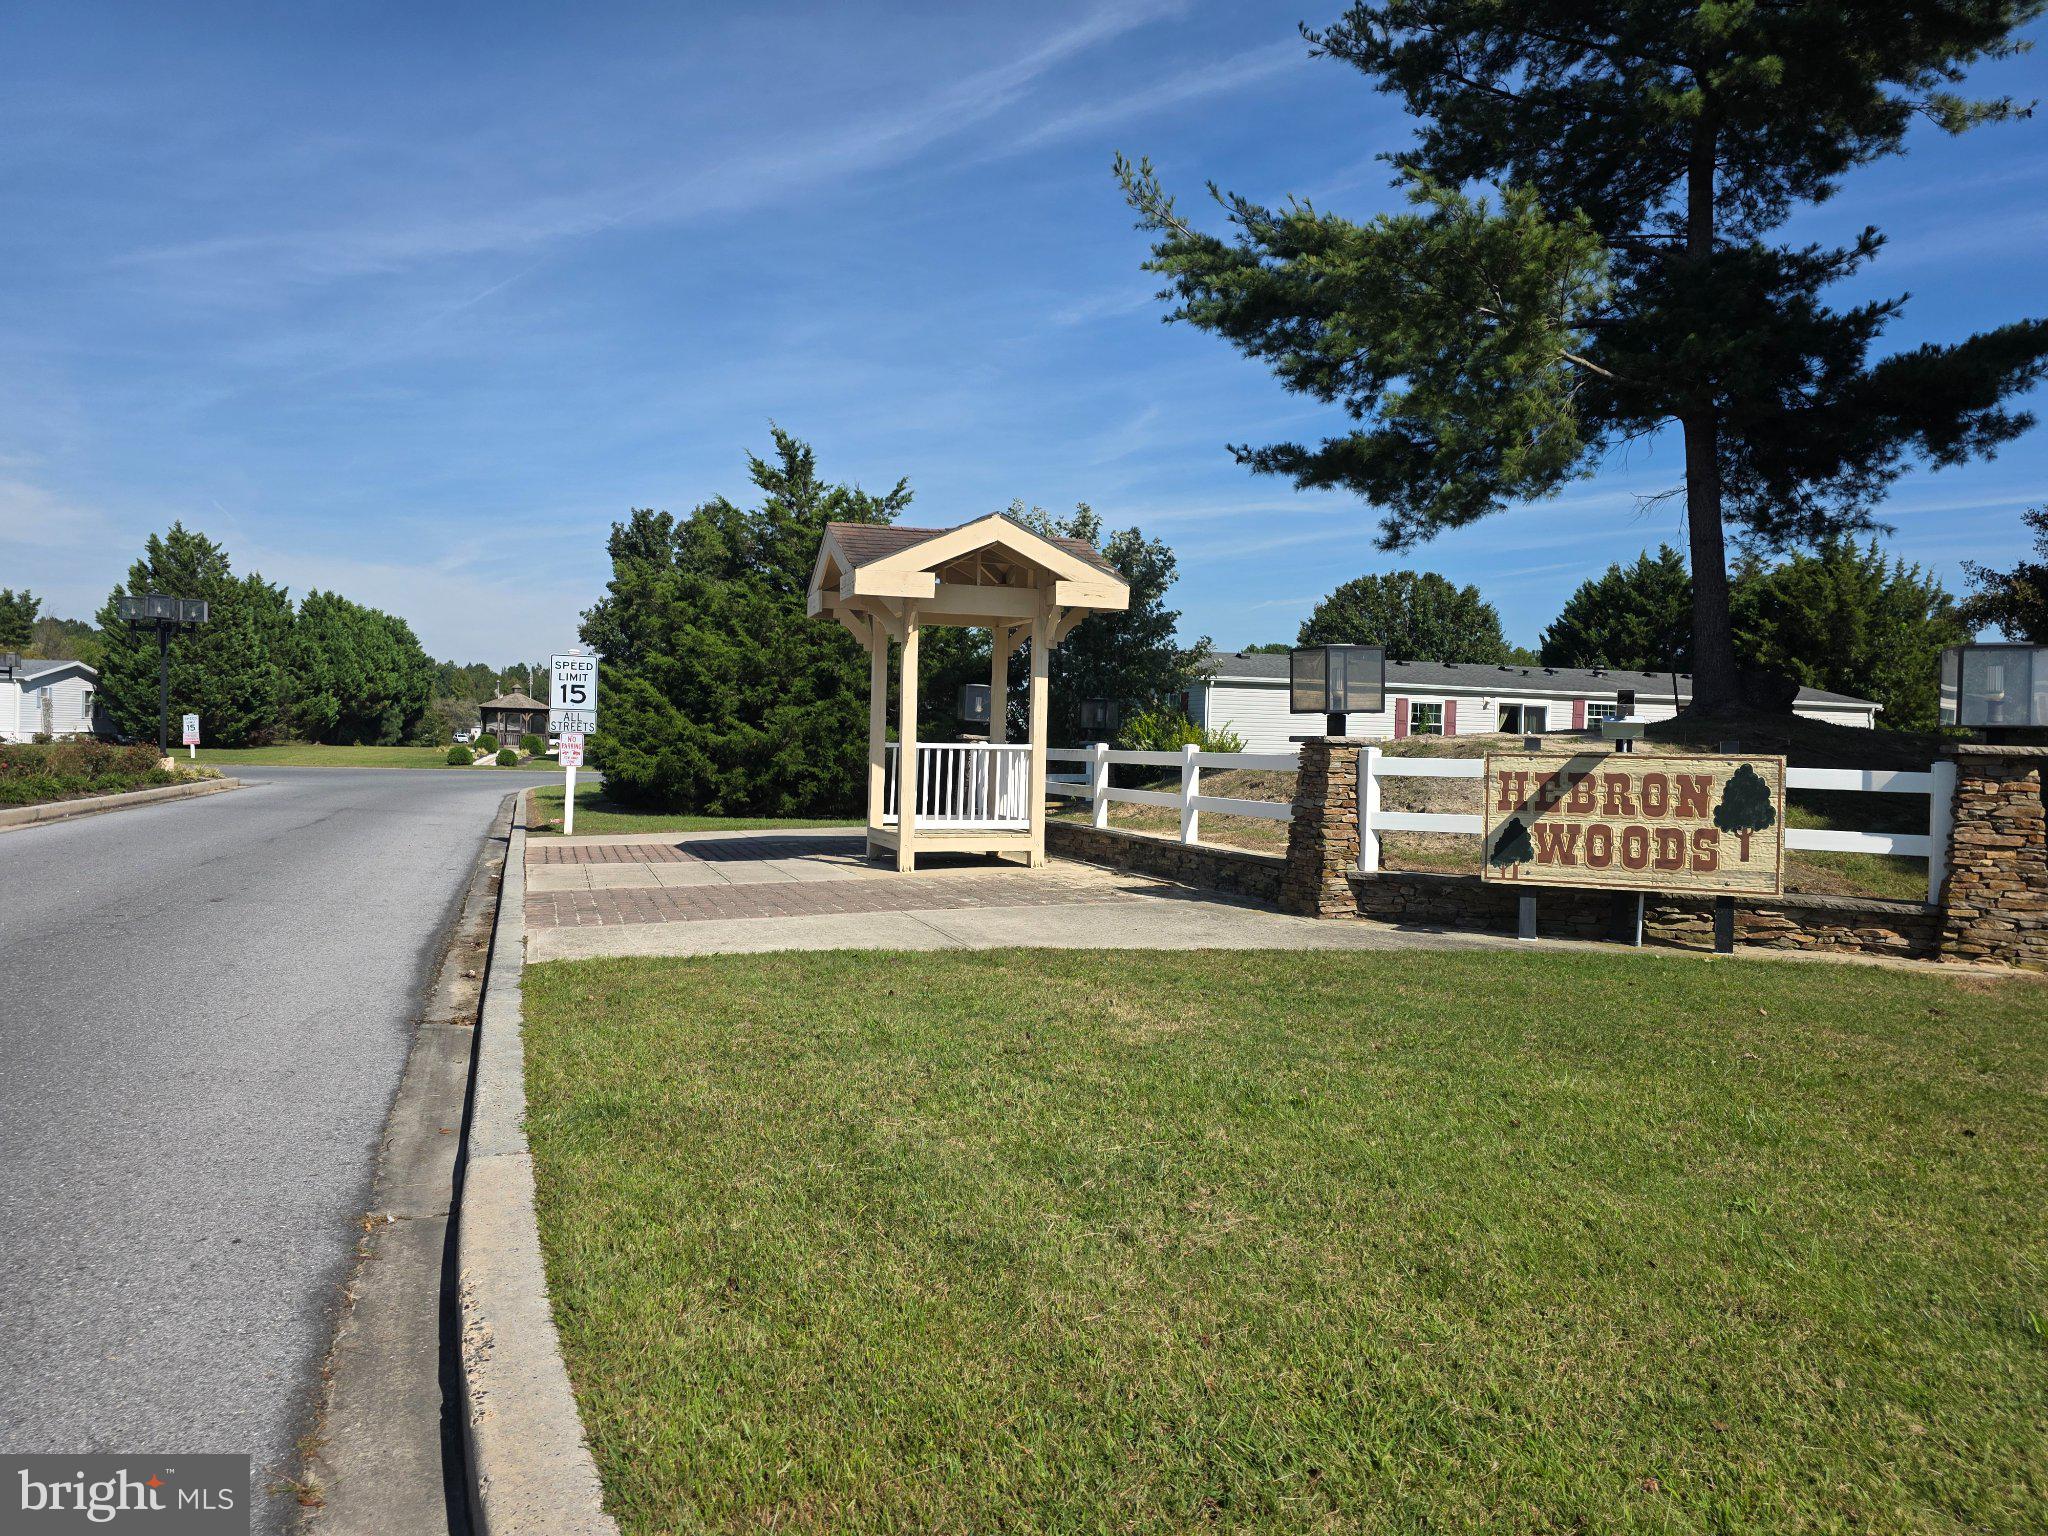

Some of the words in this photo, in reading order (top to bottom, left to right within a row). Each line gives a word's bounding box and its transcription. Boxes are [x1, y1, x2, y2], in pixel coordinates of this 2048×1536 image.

[555, 661, 593, 671] SPEED
[558, 672, 588, 682] LIMIT
[560, 684, 587, 704] 15
[563, 712, 581, 721] ALL
[550, 721, 595, 732] STREETS
[1497, 770, 1714, 818] HEBRON
[1532, 822, 1720, 873] WOODS
